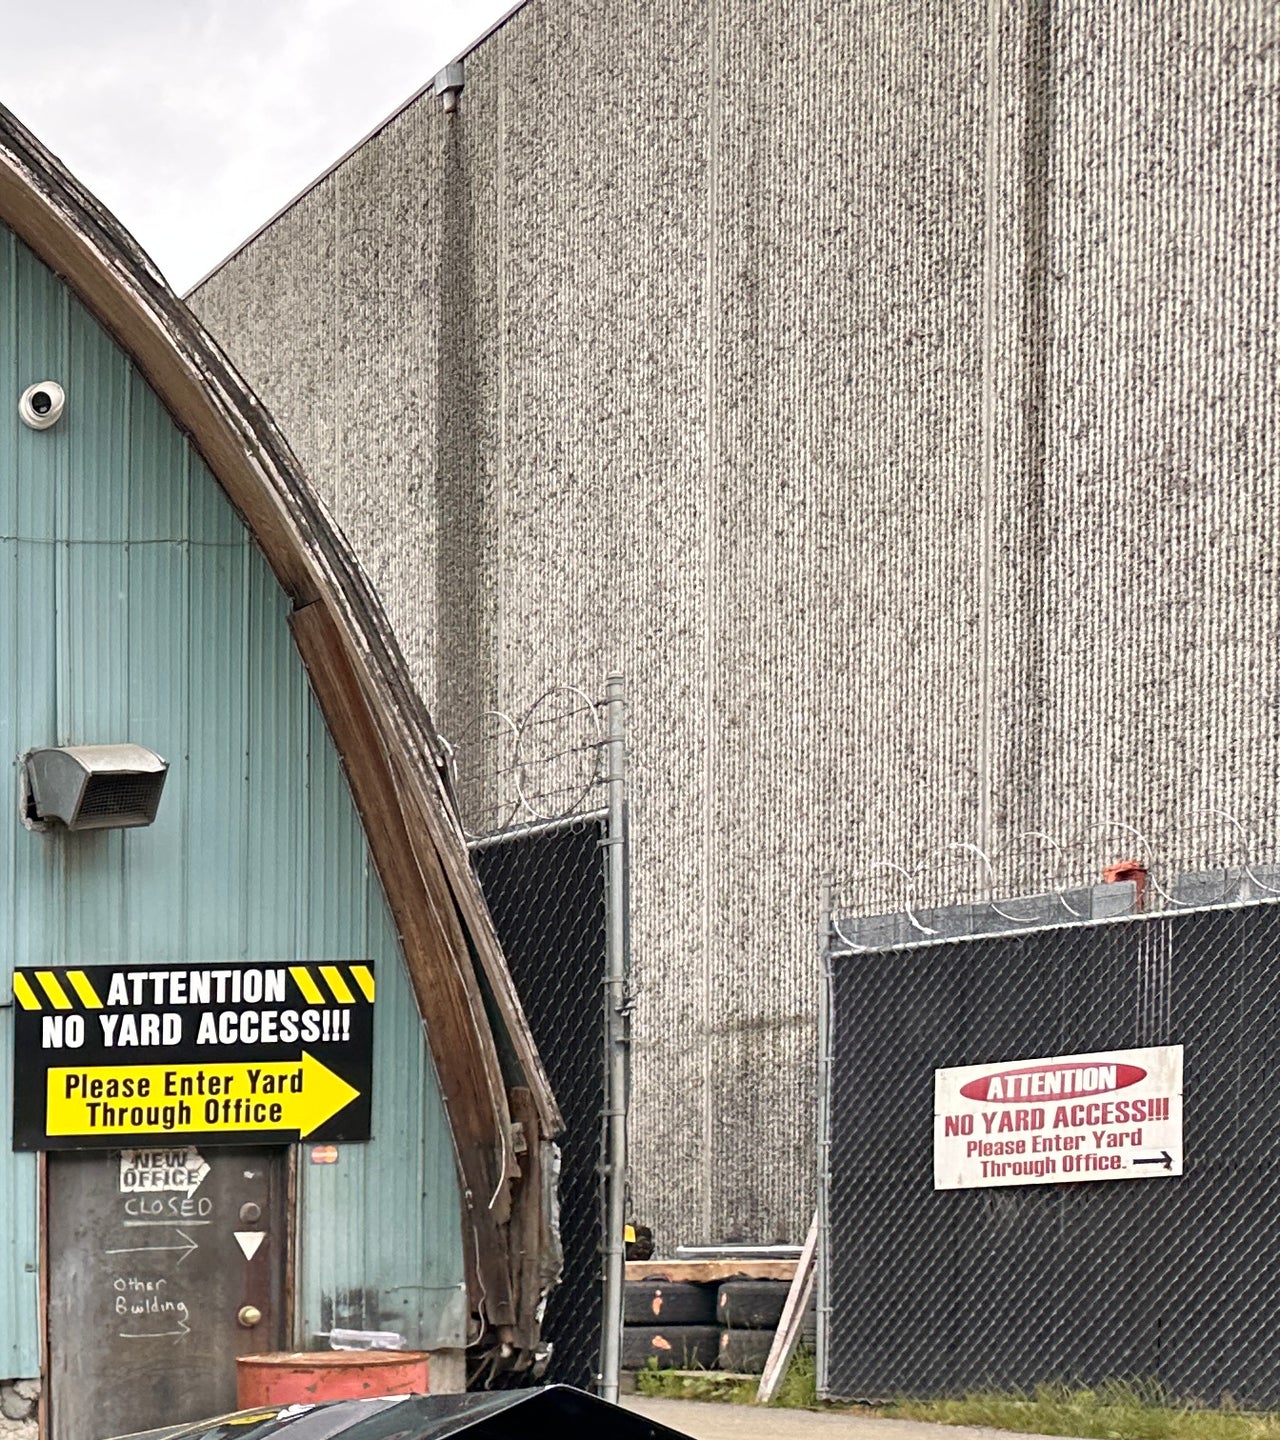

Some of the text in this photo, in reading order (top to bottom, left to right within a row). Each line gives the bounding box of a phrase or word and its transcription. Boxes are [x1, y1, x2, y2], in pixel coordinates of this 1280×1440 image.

[107, 968, 286, 1006] ATTENTION
[42, 1008, 351, 1049] NO YARD ACCESS!!!
[65, 1068, 304, 1099] Please Enter Yard
[986, 1064, 1117, 1100] ATTENTION
[86, 1097, 283, 1130] Through Office
[944, 1097, 1170, 1137] NO YARD ACCESS!!!
[967, 1128, 1143, 1158] Please Enter Yard
[134, 1151, 187, 1169] NEW
[980, 1158, 1056, 1178] Through
[124, 1167, 199, 1188] OFFICE
[113, 1277, 168, 1292] Other
[115, 1295, 189, 1321] Building
